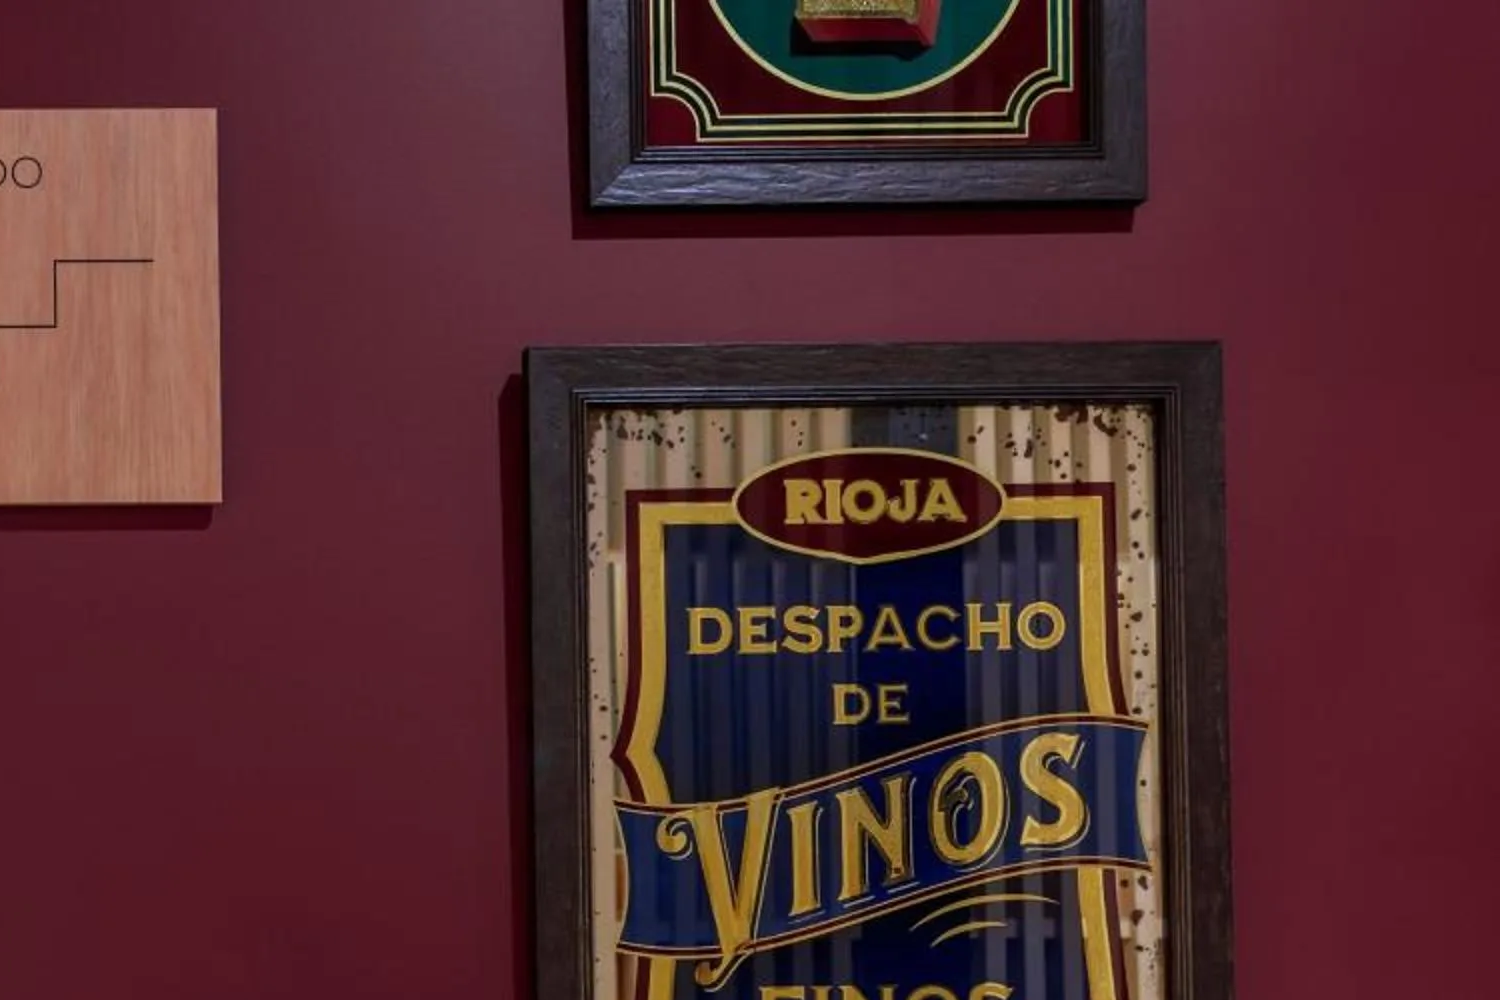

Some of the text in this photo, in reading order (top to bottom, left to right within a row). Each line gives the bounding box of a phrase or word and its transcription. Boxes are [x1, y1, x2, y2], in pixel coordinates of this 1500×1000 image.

[782, 477, 968, 525] RIOJA
[685, 600, 1067, 656] DESPACHO
[831, 682, 911, 726] DE
[656, 730, 1090, 991] VINOS
